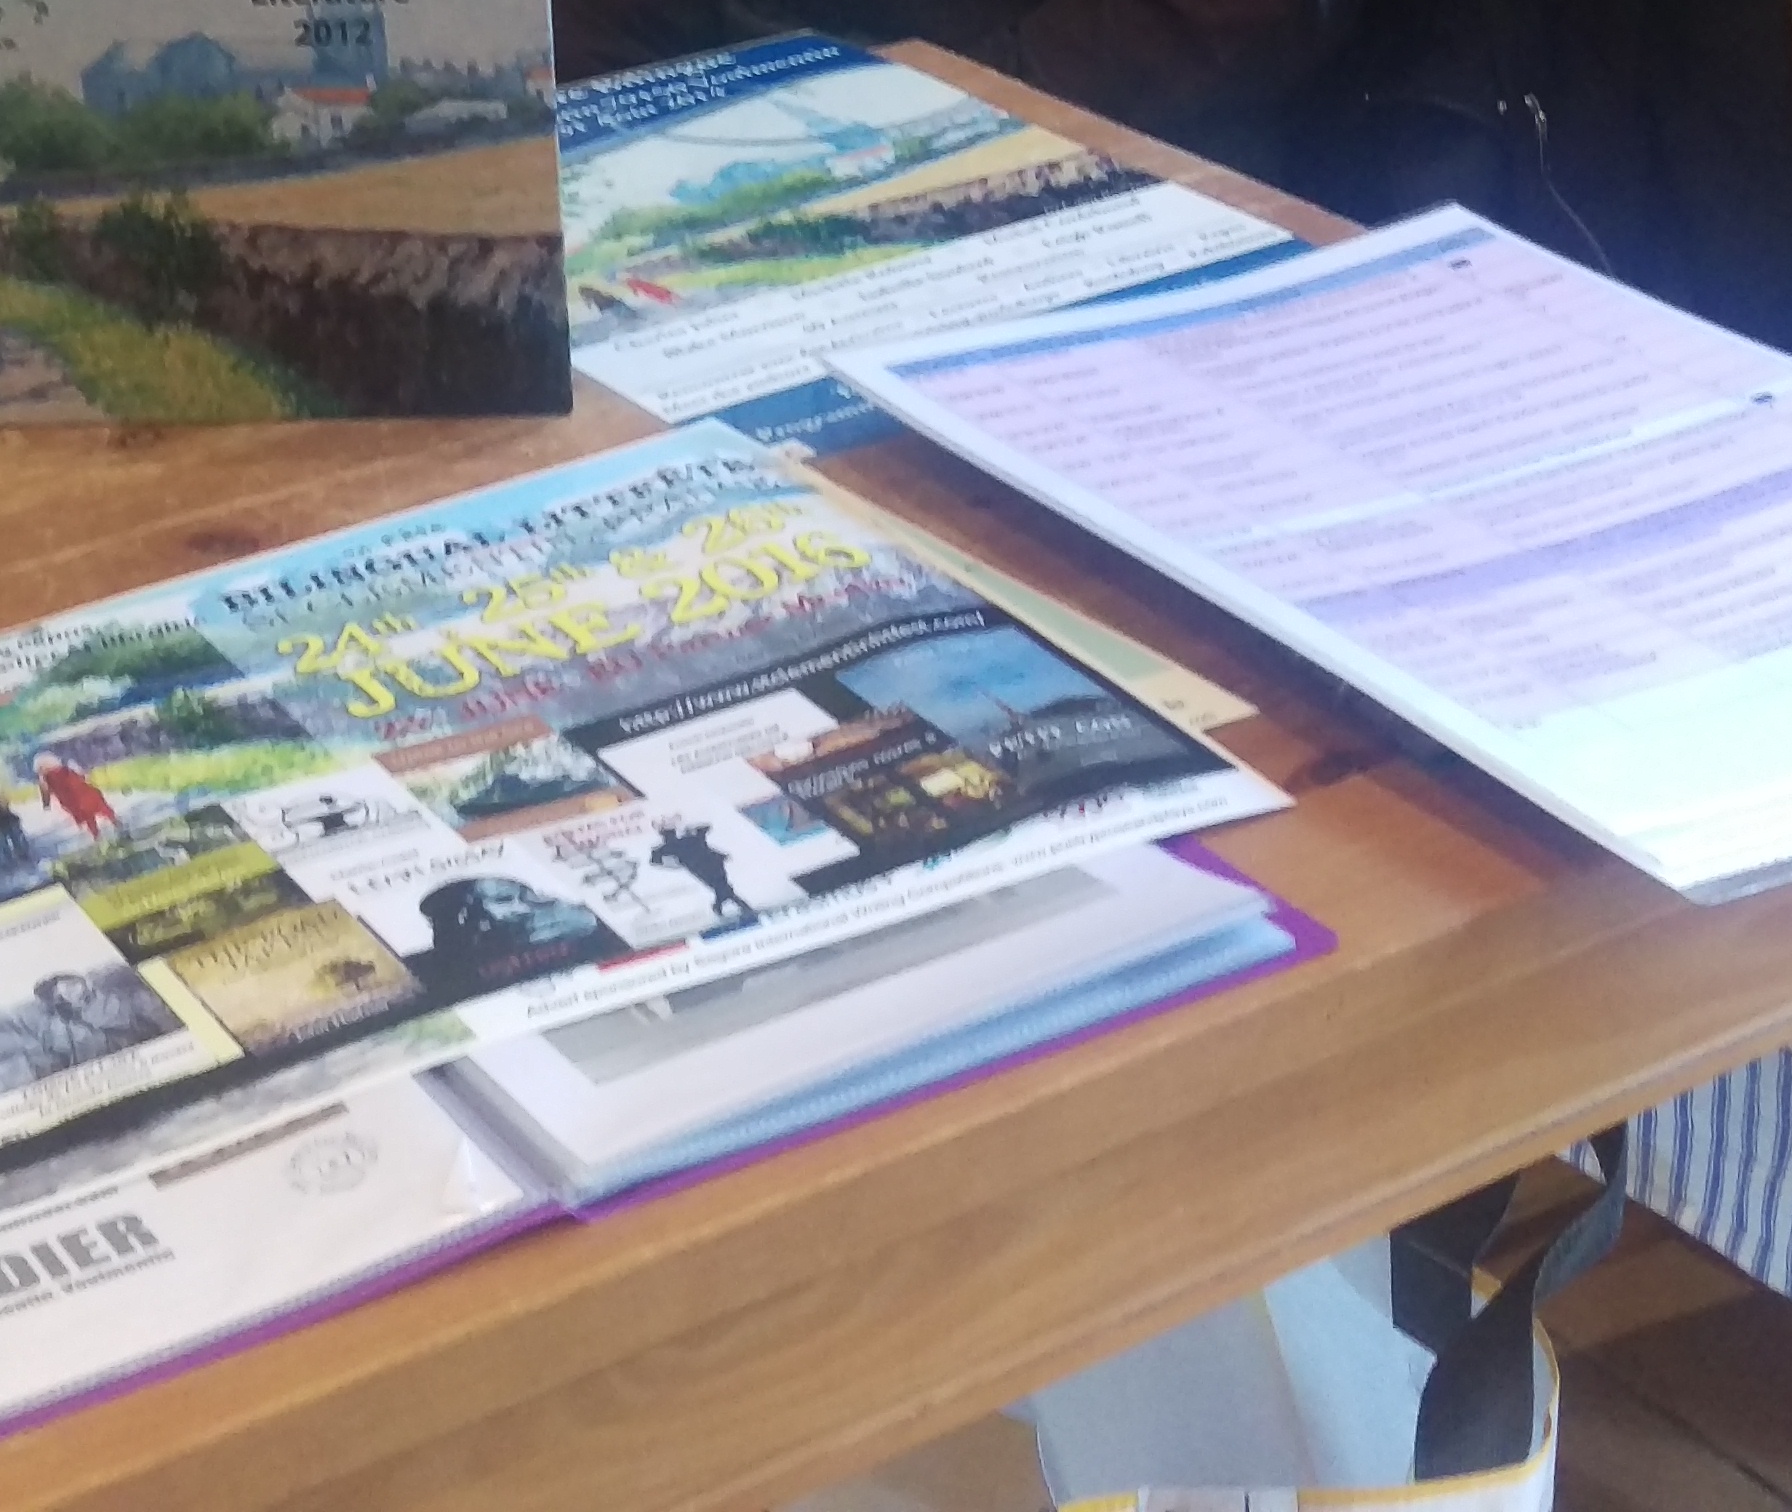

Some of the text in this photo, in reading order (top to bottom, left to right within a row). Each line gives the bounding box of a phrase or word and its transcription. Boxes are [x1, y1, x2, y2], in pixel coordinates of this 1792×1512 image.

[293, 18, 374, 48] 2012
[224, 528, 489, 612] BILINGUAL
[278, 499, 806, 676] 24th 25th & 26th
[338, 601, 643, 718] JUNE
[639, 528, 874, 626] 2016
